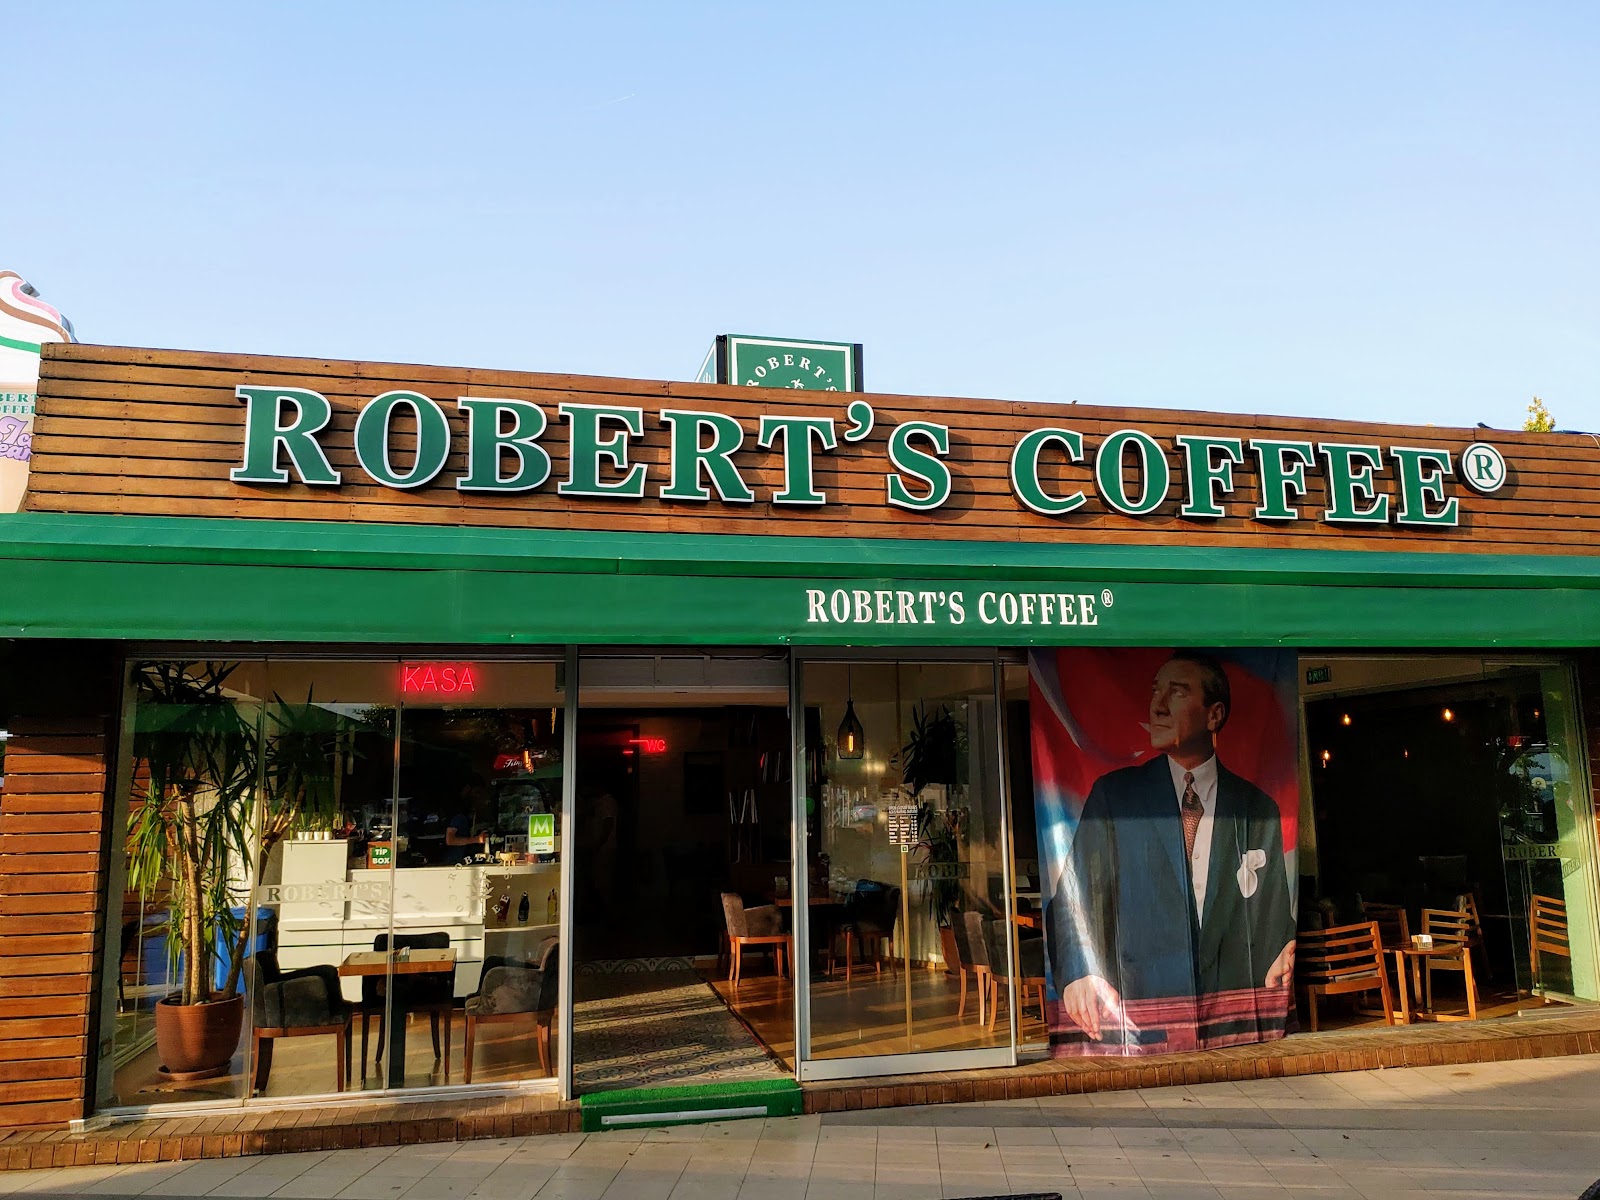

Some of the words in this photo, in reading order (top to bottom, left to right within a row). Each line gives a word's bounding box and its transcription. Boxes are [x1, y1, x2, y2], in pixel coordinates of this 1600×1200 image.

[229, 384, 951, 511] ROBERT'S
[805, 588, 966, 625] ROBERT'S
[401, 666, 475, 692] KASA
[646, 739, 666, 752] WC
[266, 883, 382, 902] ROBERT'S
